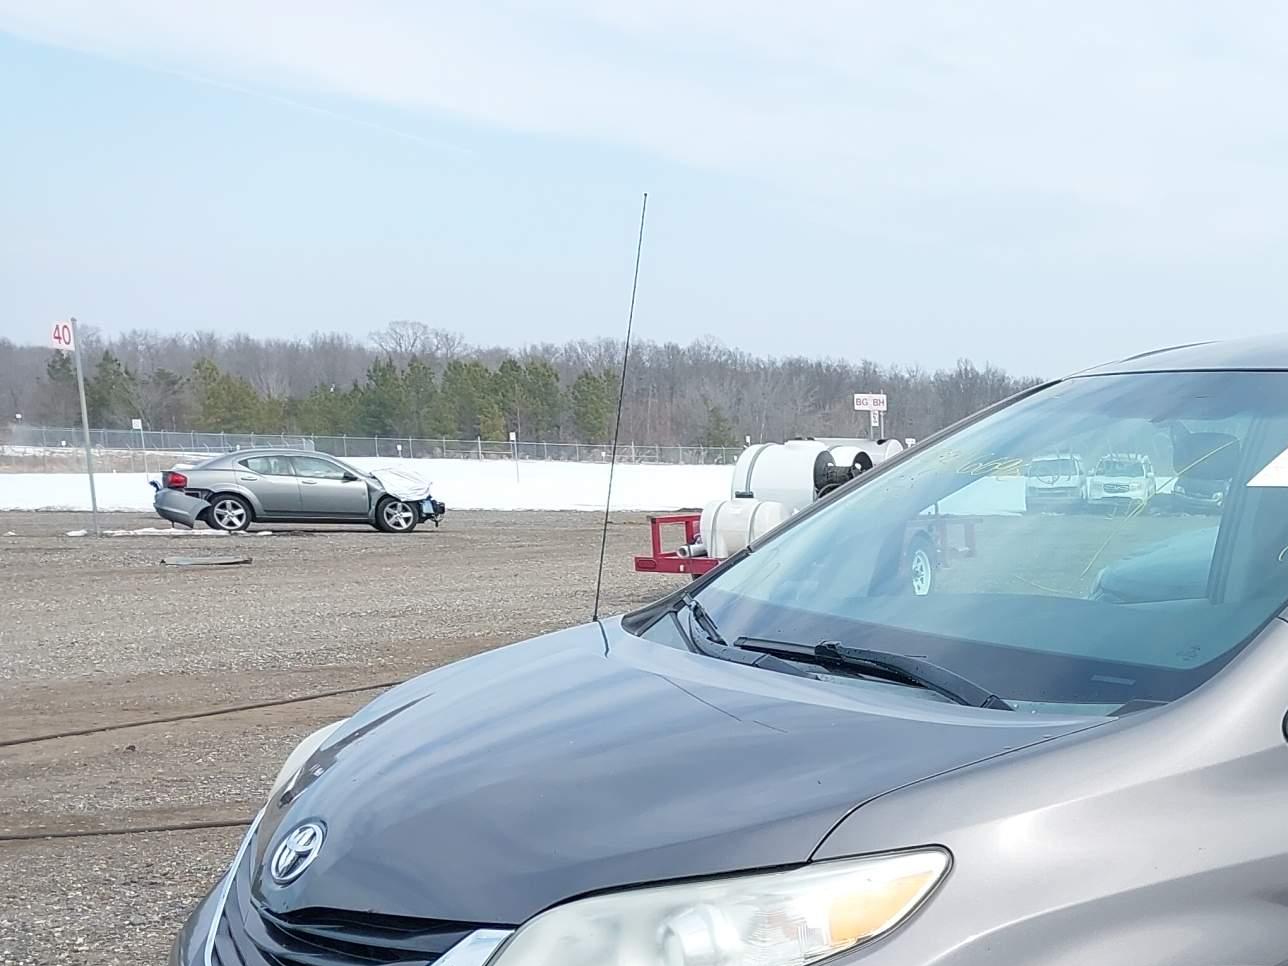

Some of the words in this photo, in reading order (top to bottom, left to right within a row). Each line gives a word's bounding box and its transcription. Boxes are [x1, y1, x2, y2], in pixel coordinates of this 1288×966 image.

[53, 324, 71, 345] 40
[855, 398, 869, 406] BG
[872, 398, 885, 407] BH
